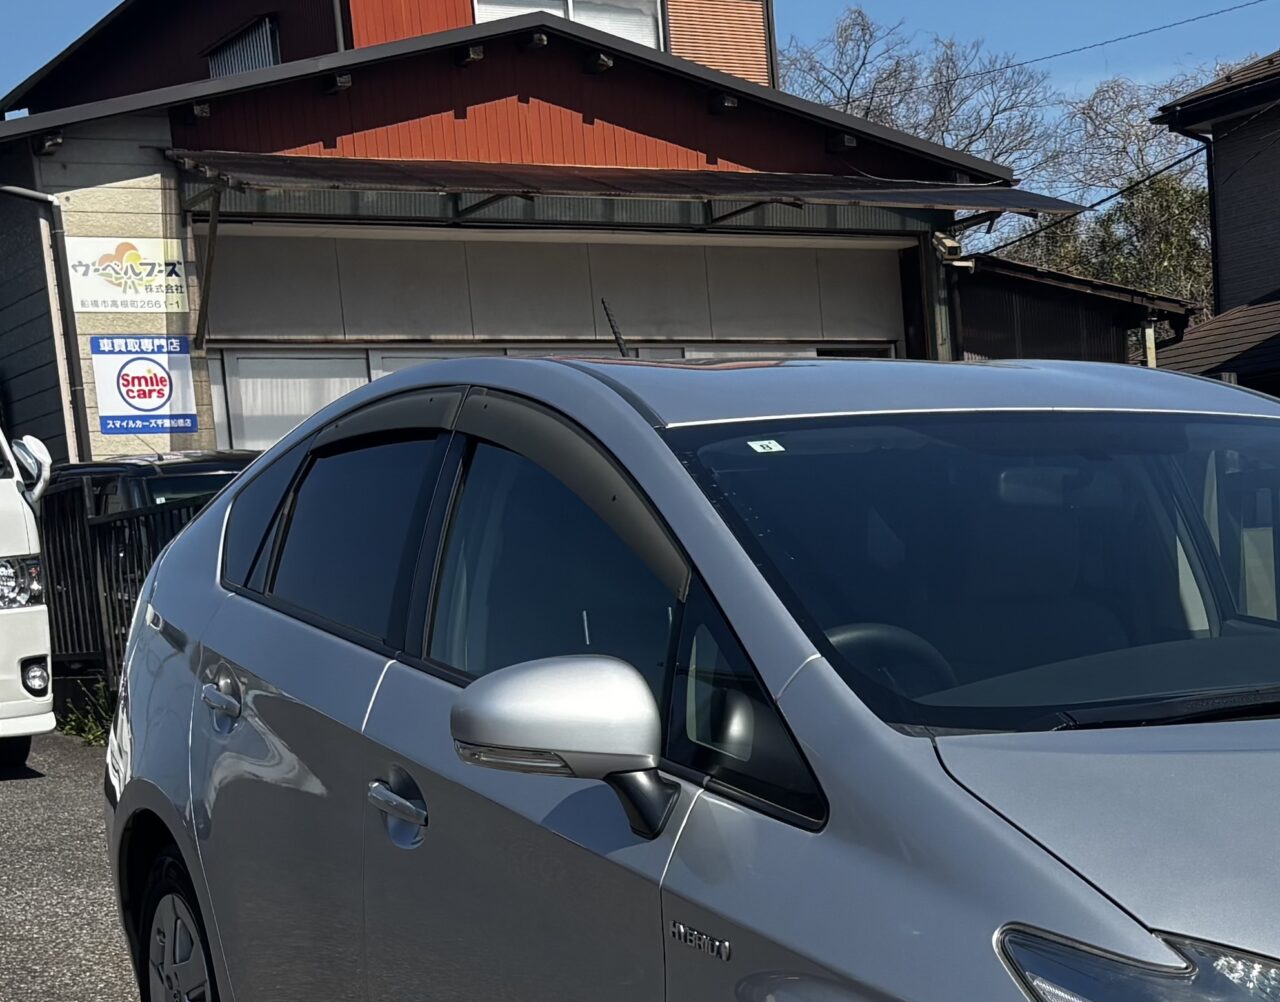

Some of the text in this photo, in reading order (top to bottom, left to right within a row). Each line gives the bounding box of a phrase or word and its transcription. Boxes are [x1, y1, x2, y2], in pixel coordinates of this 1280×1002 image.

[144, 284, 184, 294] 株式会社
[99, 339, 181, 352] 車買取専門店
[121, 373, 168, 388] Smile
[126, 387, 165, 399] cars
